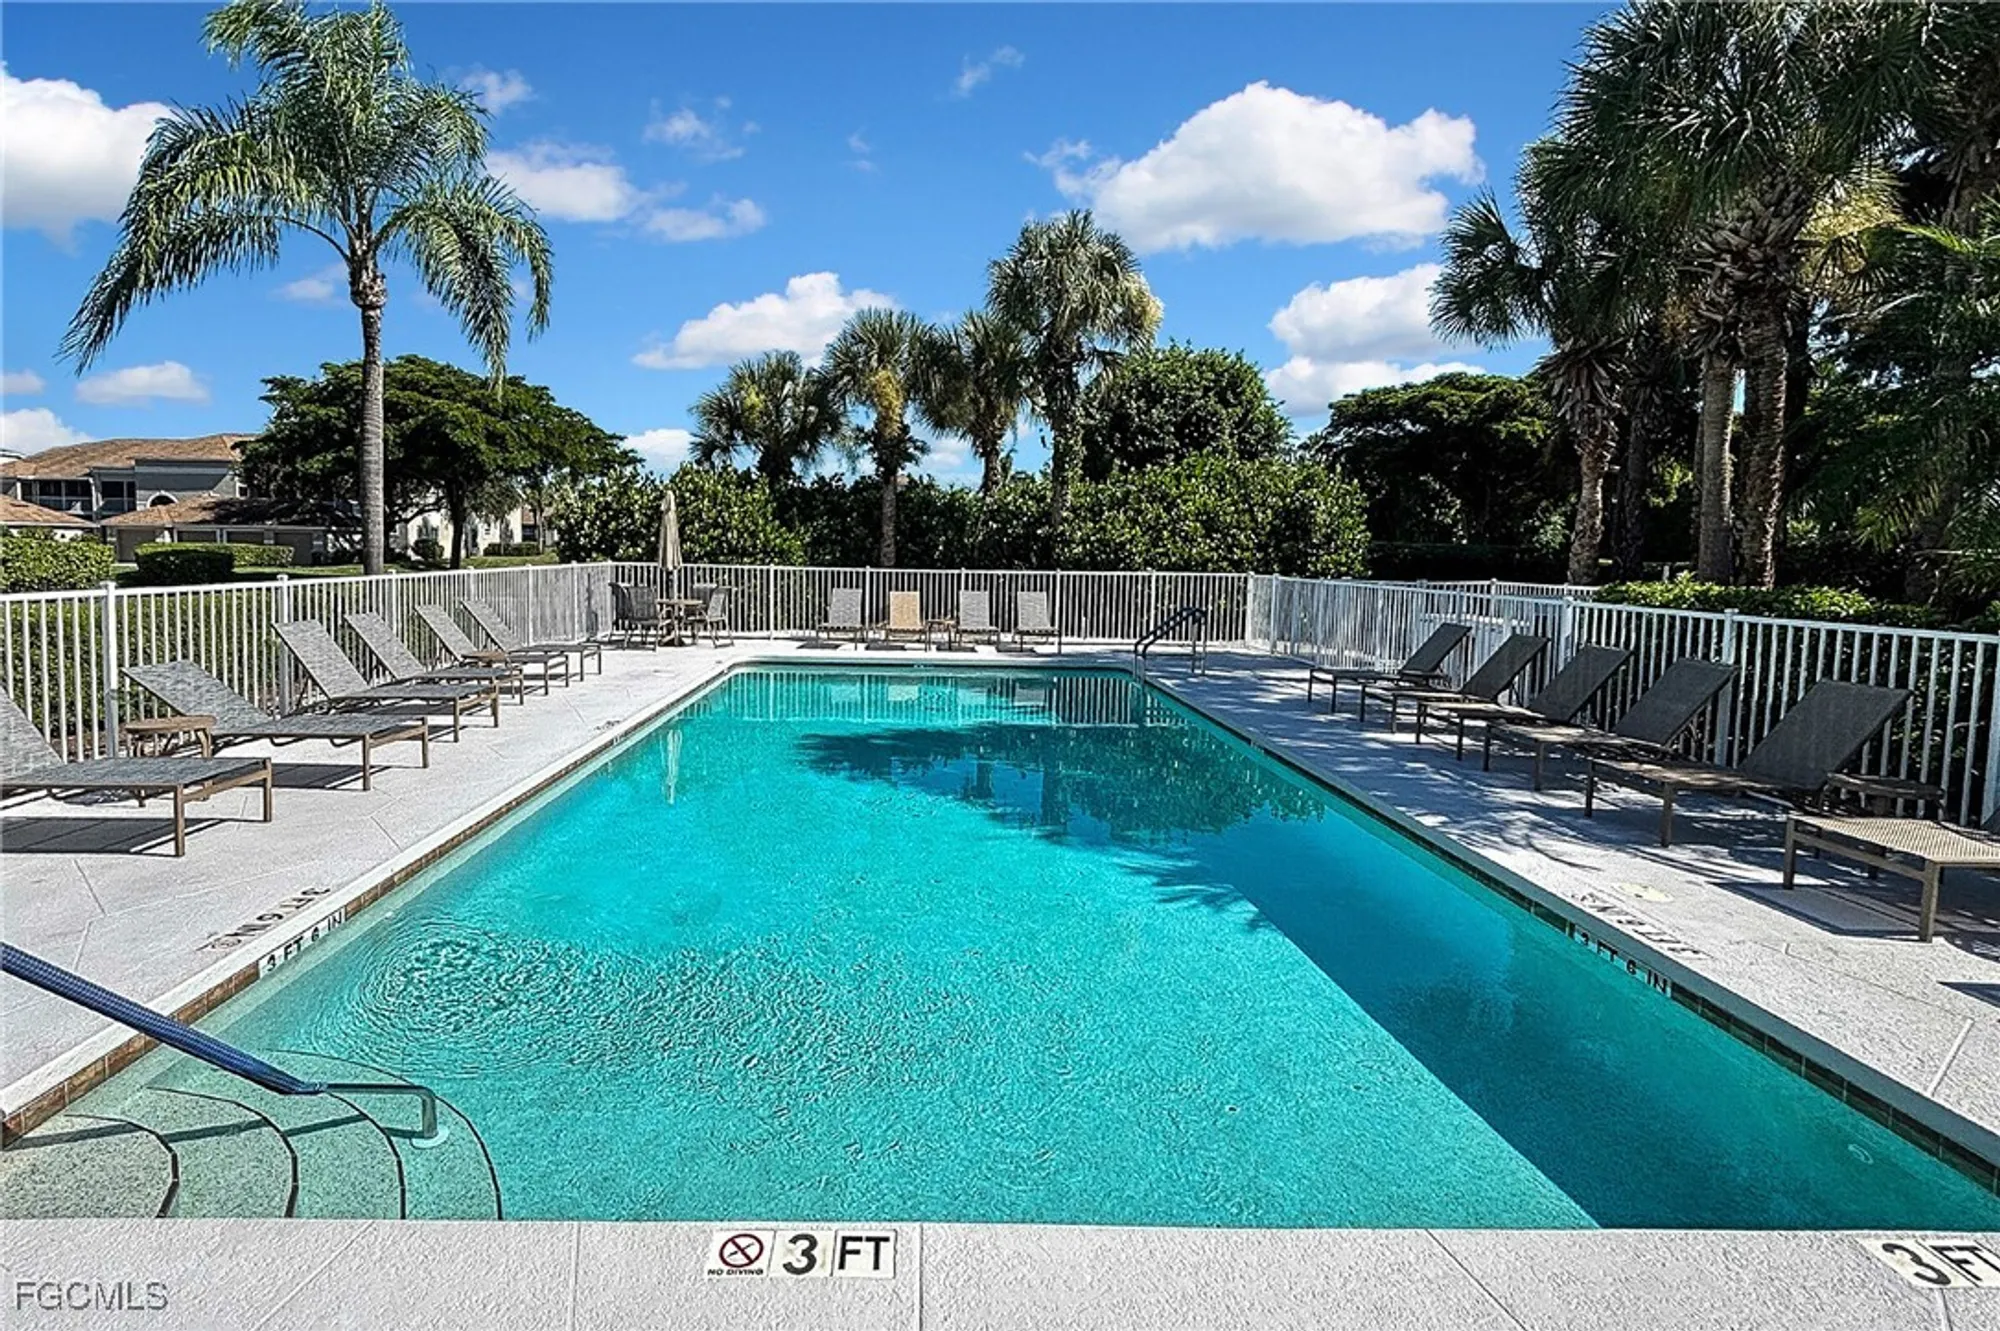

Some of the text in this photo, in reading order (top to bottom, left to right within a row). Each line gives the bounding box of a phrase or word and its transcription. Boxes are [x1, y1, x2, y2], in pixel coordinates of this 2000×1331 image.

[267, 911, 342, 972] 3 FT 6 IN
[1580, 931, 1668, 995] 3 FT 6 IN
[707, 1268, 764, 1276] NO DIVING
[782, 1233, 890, 1276] 3 FT
[1882, 1243, 2000, 1286] 3 FT
